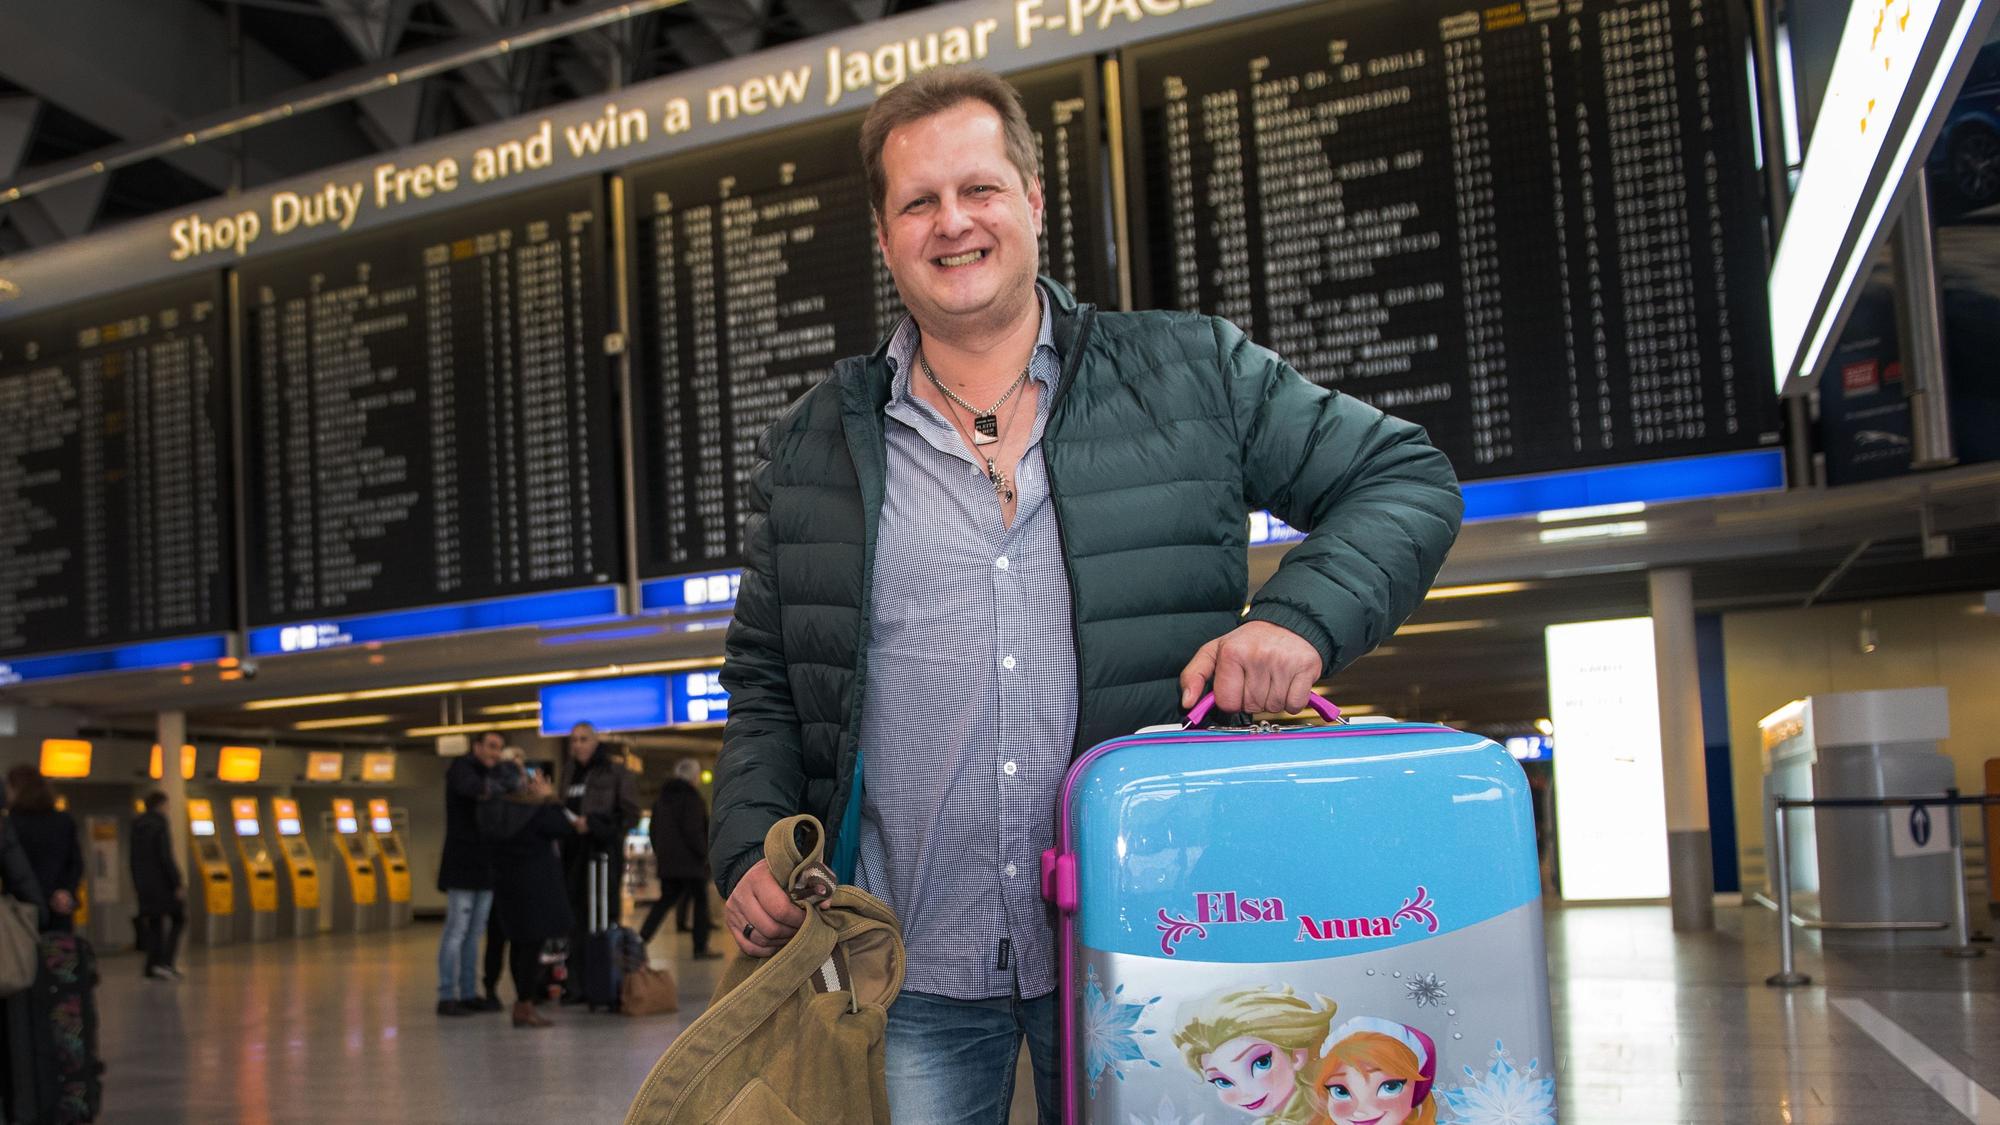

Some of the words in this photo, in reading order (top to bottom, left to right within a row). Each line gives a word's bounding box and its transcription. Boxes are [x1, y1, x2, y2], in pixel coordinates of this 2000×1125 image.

[170, 209, 260, 262] Shop
[271, 182, 363, 235] Duty
[374, 156, 459, 208] Free
[472, 120, 553, 184] and
[566, 103, 648, 159] win
[663, 97, 690, 133] a
[708, 65, 812, 124] new
[825, 18, 997, 103] Jaguar
[1015, 0, 1214, 48] F-PA
[1194, 891, 1287, 924] Elsa
[1295, 915, 1393, 942] Anna
